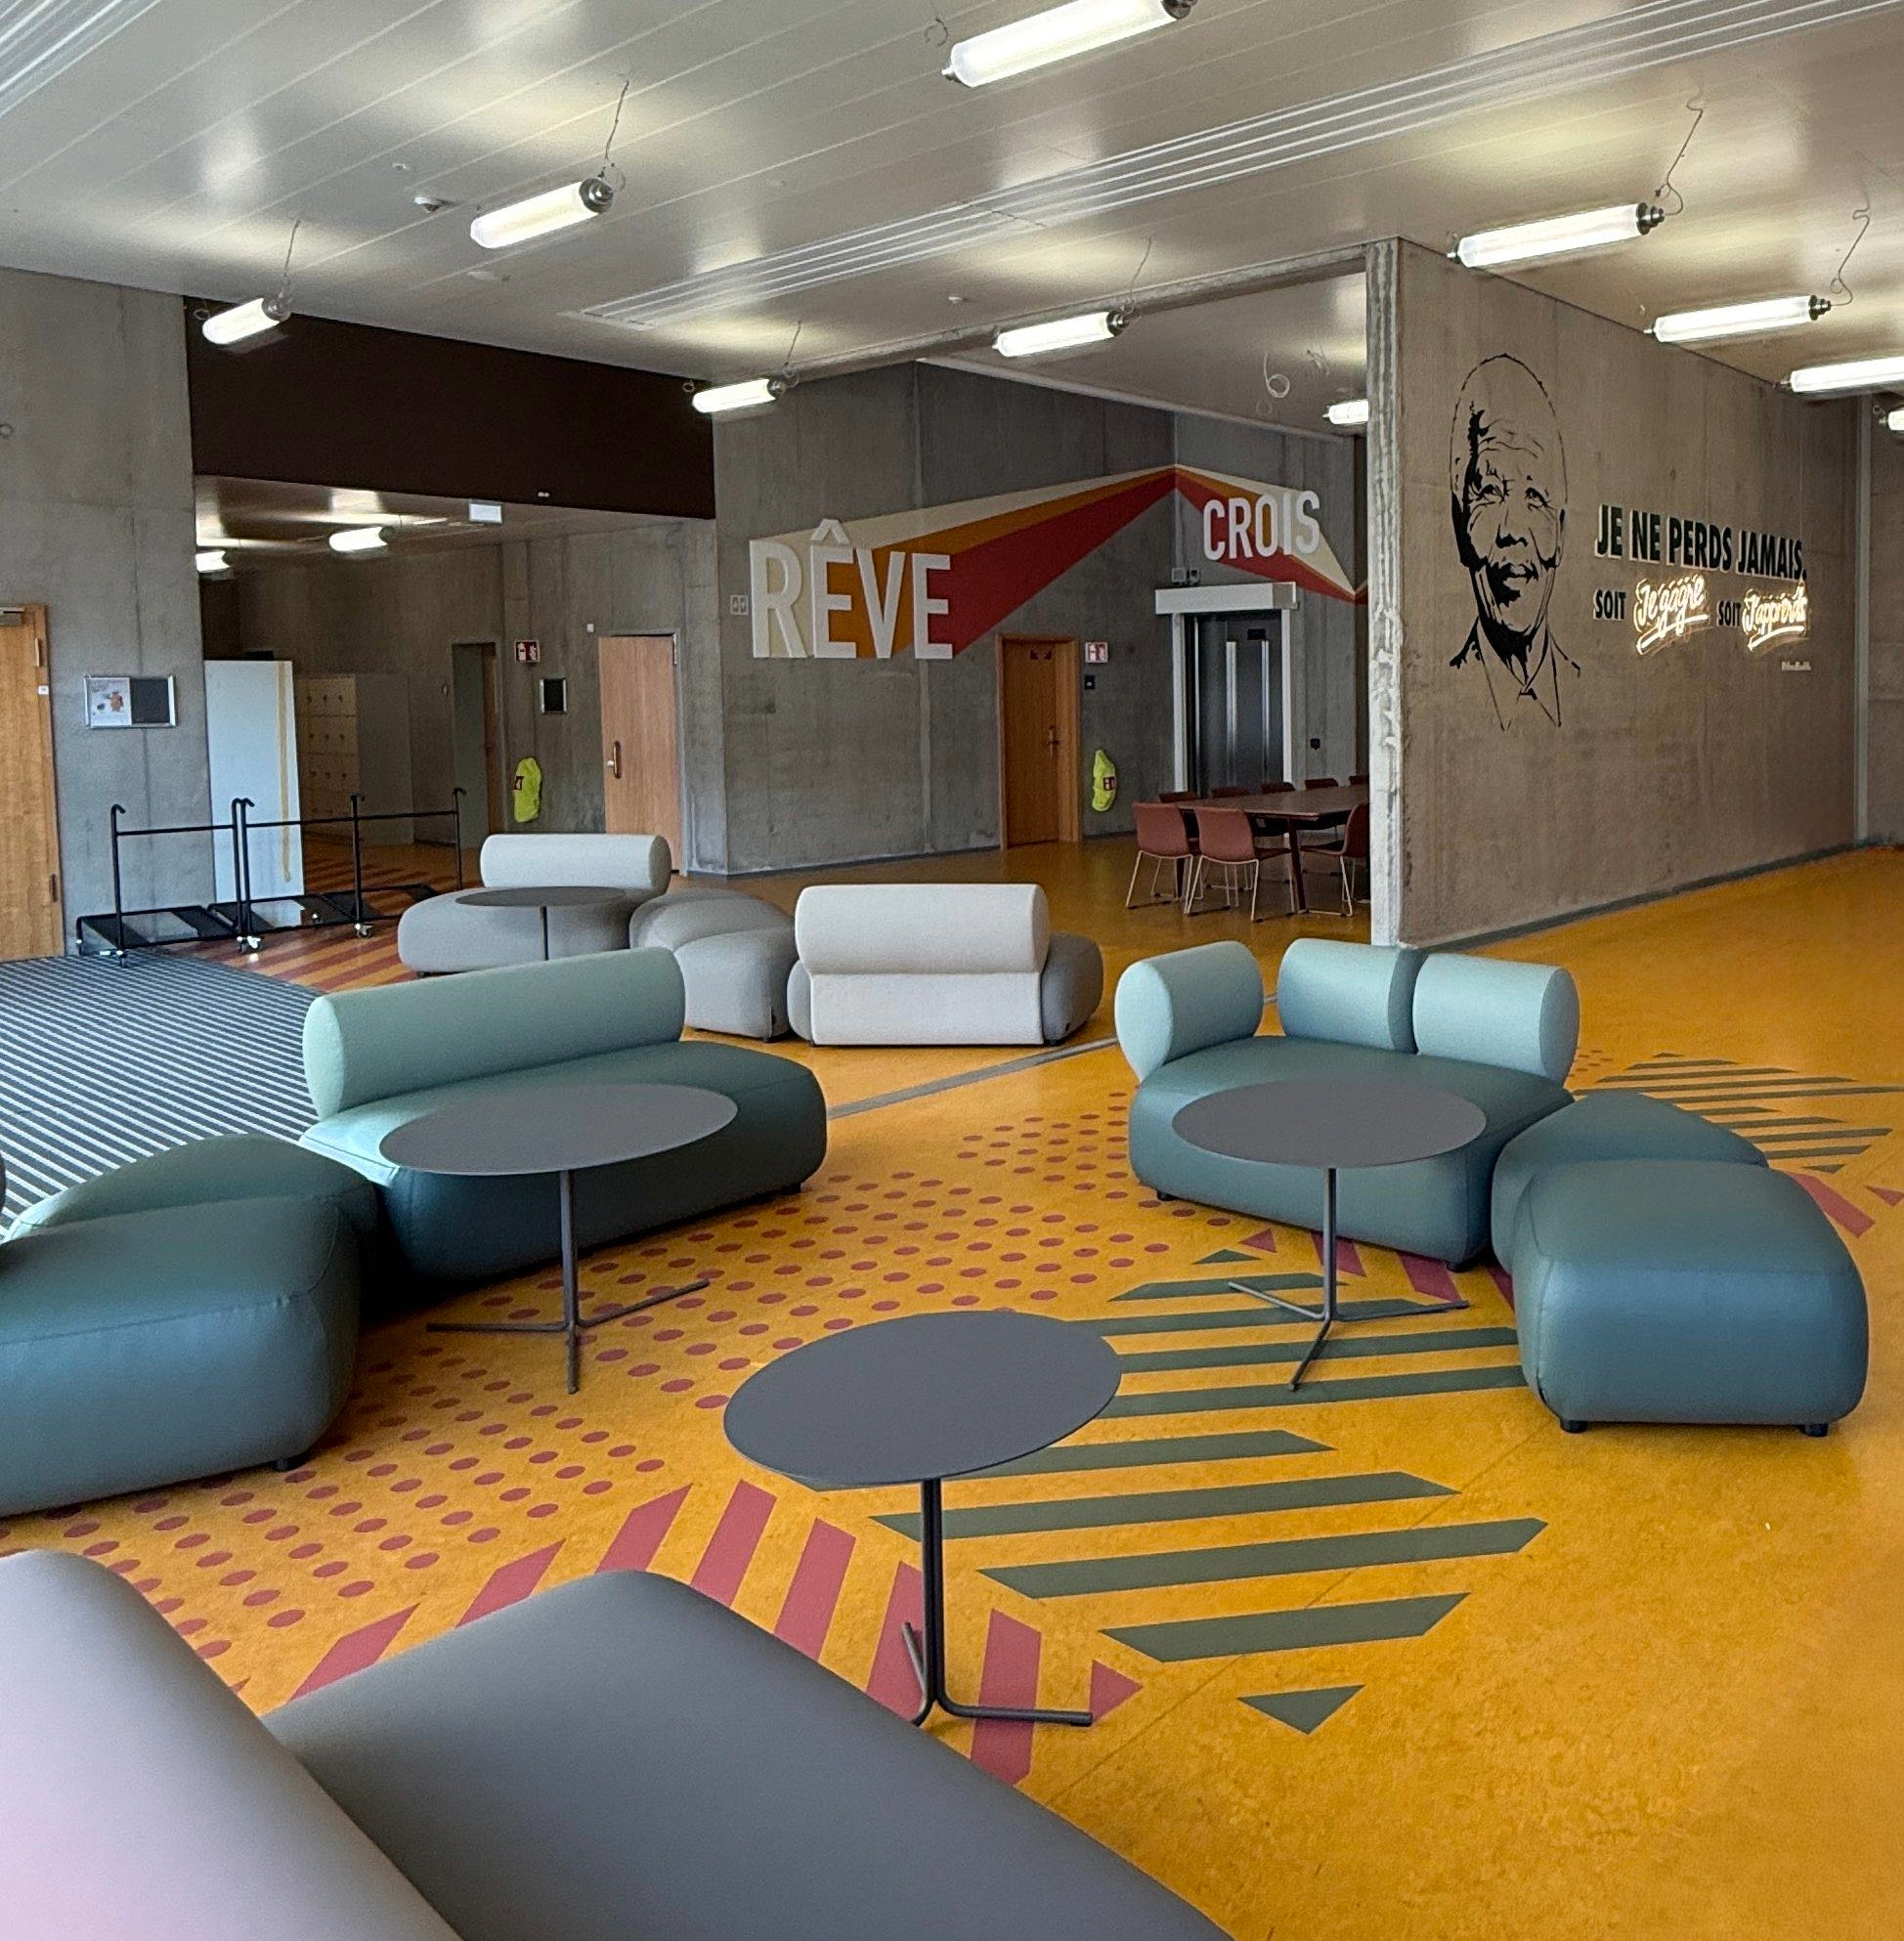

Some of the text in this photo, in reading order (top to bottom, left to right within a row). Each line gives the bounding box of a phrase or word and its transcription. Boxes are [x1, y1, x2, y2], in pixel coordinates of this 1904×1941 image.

[1203, 490, 1320, 561] CROIS
[1594, 503, 1623, 560] JE
[1629, 509, 1661, 565] NE
[1666, 516, 1733, 574] PERDS
[749, 518, 954, 660] RÊVE
[1593, 588, 1626, 622] SOIT
[1716, 600, 1742, 627] SOIT
